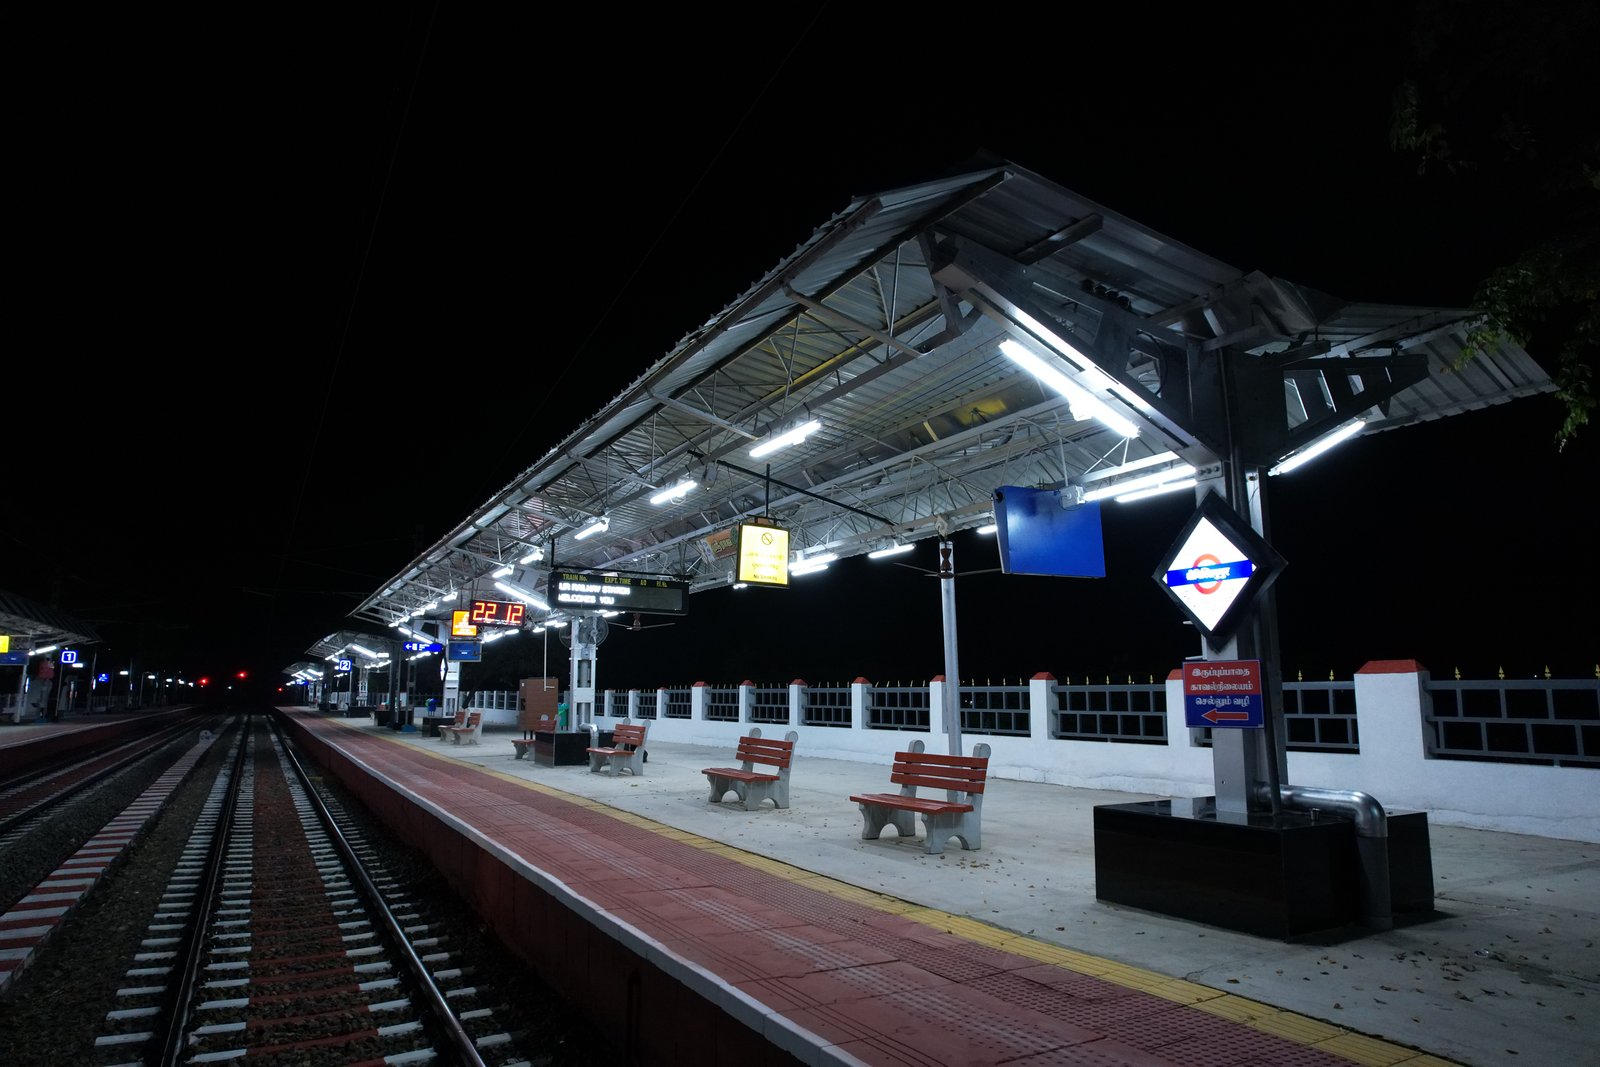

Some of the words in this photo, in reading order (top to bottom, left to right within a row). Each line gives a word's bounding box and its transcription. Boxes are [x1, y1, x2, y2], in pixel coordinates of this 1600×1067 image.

[562, 573, 578, 581] TRAIN
[619, 577, 631, 585] TIME
[571, 583, 601, 593] RAILWAY
[602, 585, 631, 595] STATION
[599, 596, 615, 604] YOU
[472, 602, 497, 622] 22
[506, 604, 523, 624] 12
[1191, 666, 1250, 678] இருப்புப்பாதை
[1190, 680, 1254, 692] காவல்நிலையம்
[1195, 695, 1232, 708] செல்லும்
[1233, 695, 1250, 708] வழி
